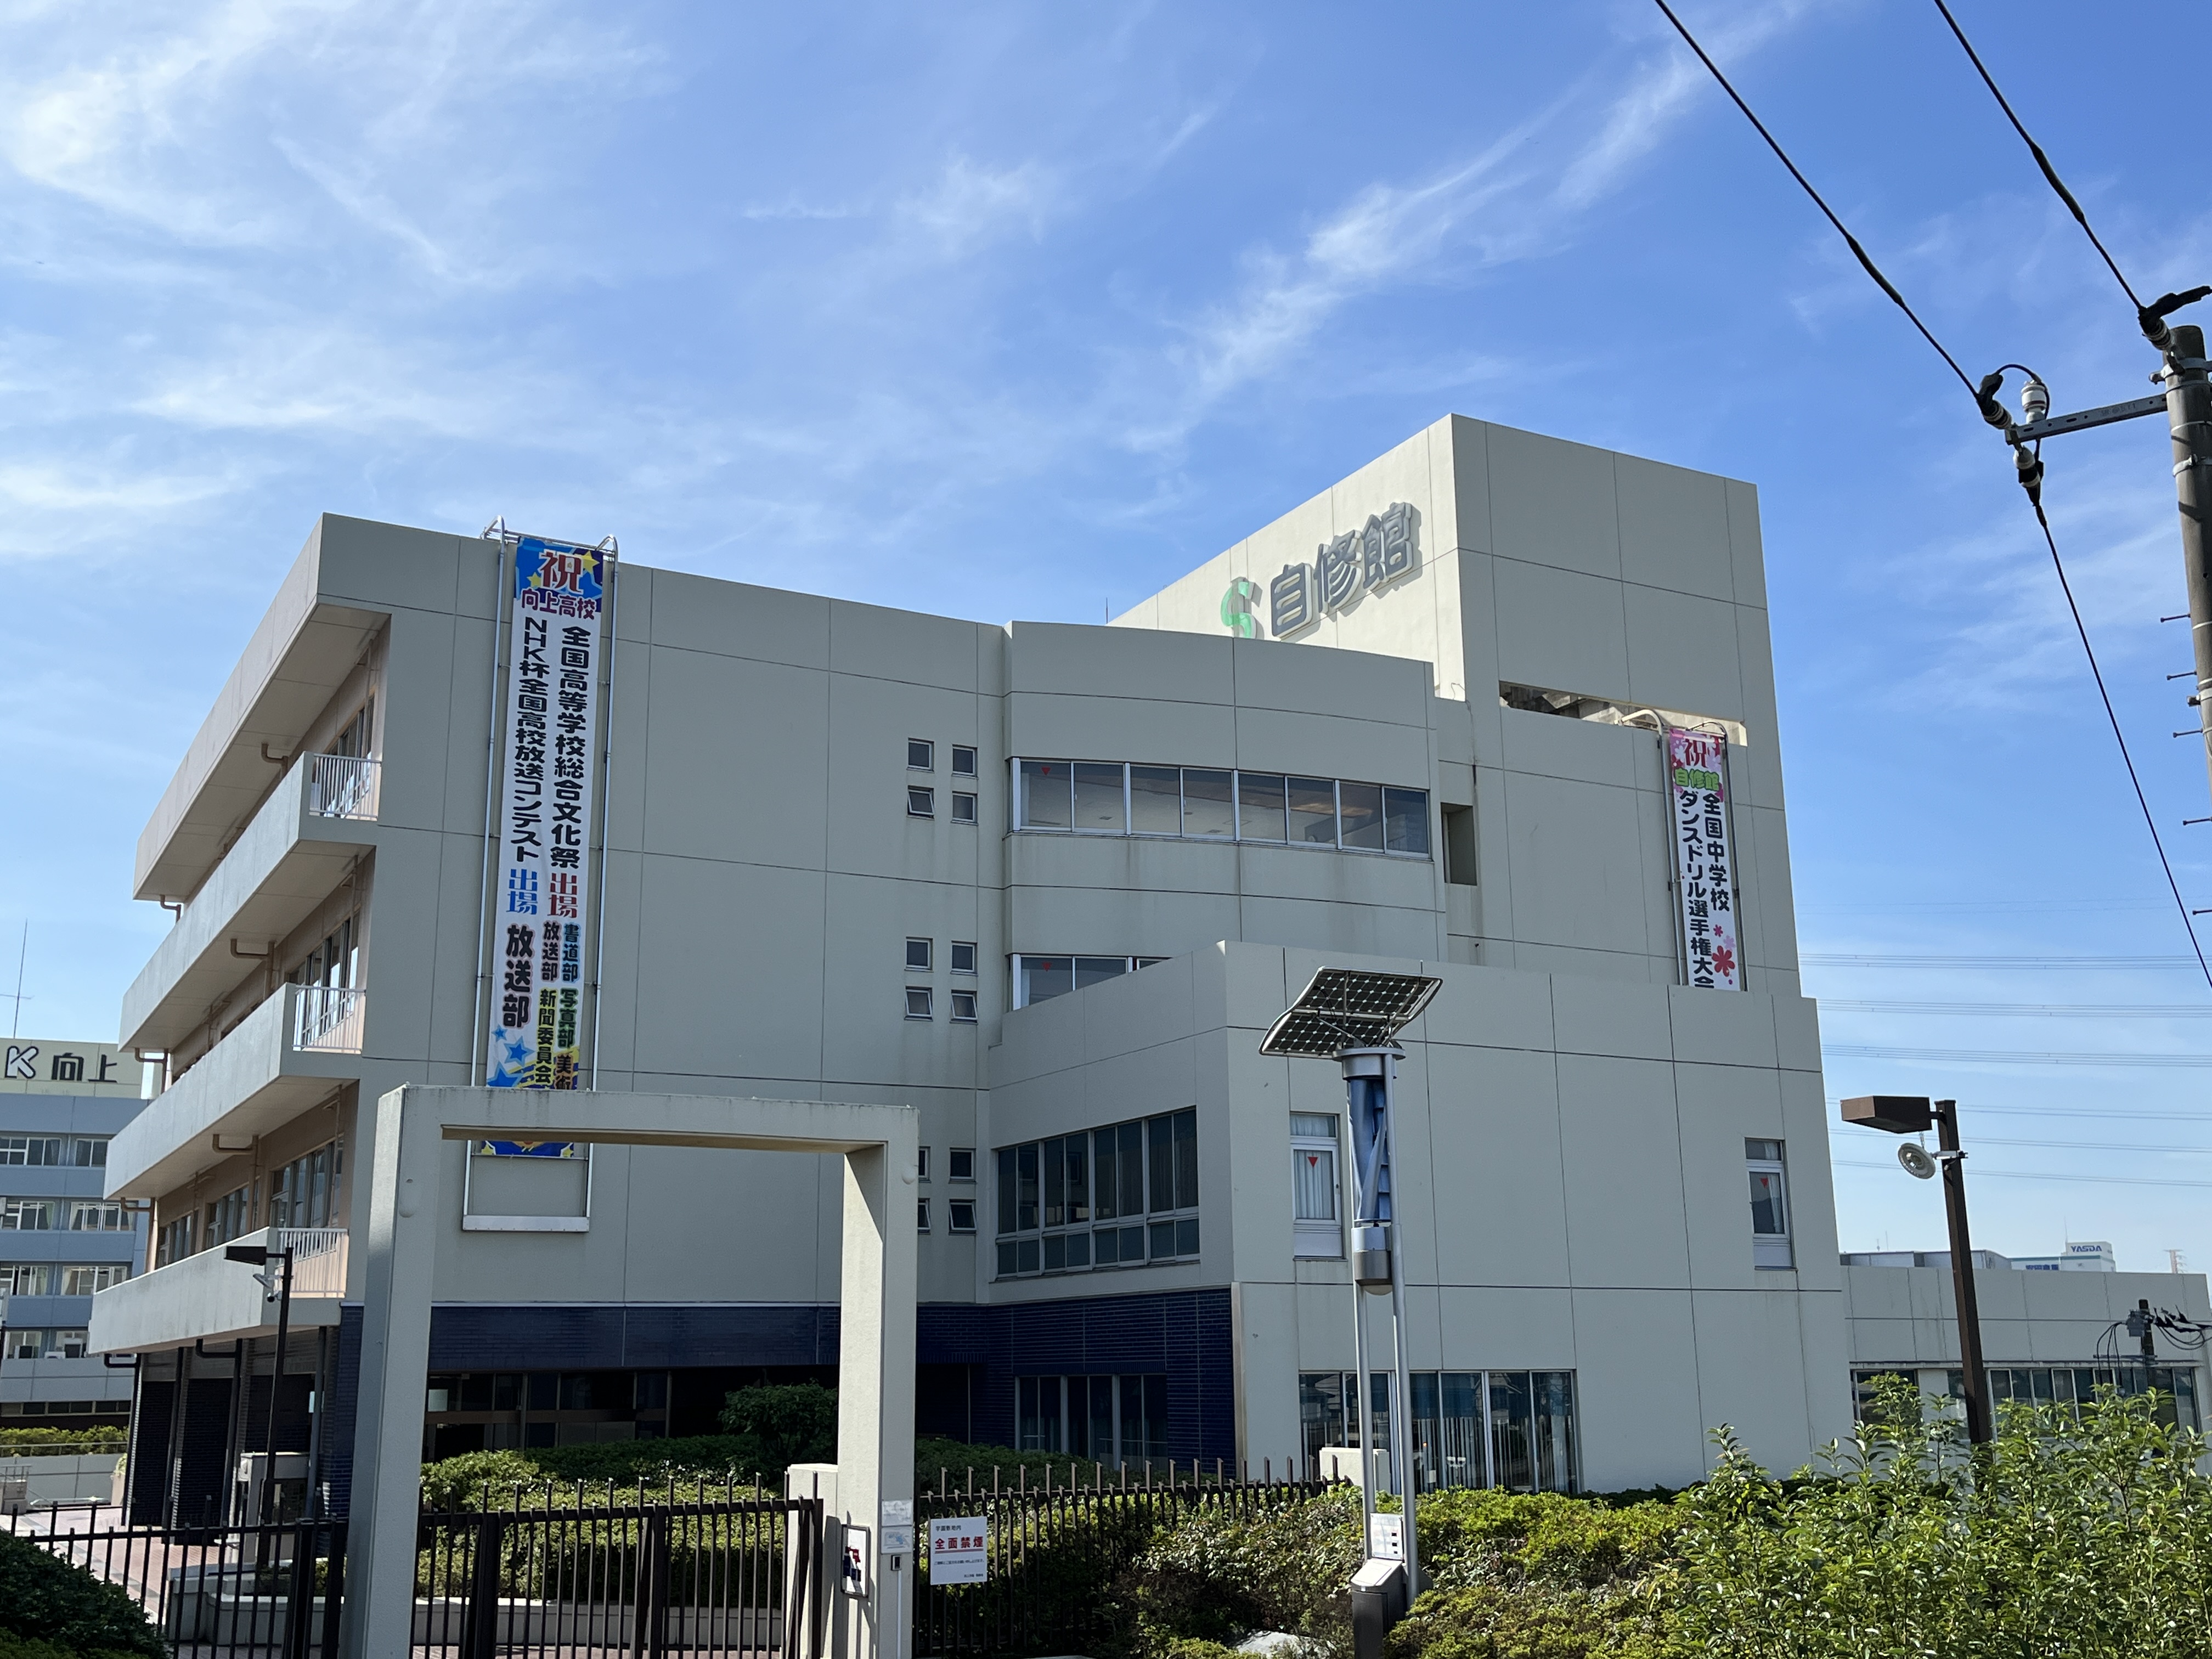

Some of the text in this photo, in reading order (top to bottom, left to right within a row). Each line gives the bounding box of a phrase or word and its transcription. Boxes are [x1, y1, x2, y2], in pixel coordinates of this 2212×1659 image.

[540, 550, 583, 593] 祝
[1270, 502, 1414, 637] 自修館
[521, 589, 596, 620] 向上高校
[547, 626, 591, 918] 全国高等学校総合文化祭 出場
[1684, 738, 1708, 768] 祝
[1674, 767, 1719, 792] 自修館
[503, 617, 549, 1028] NHK杯全国高校放送コンテスト 出場 放送部
[1702, 793, 1730, 912] 全国中学校
[562, 923, 579, 982] 書道部
[535, 922, 560, 1084] 放送部 新聞委員会
[557, 989, 578, 1048] 写真部
[5, 1046, 38, 1079] K
[52, 1052, 117, 1083] 向上
[935, 1536, 983, 1549] 全面禁煙
